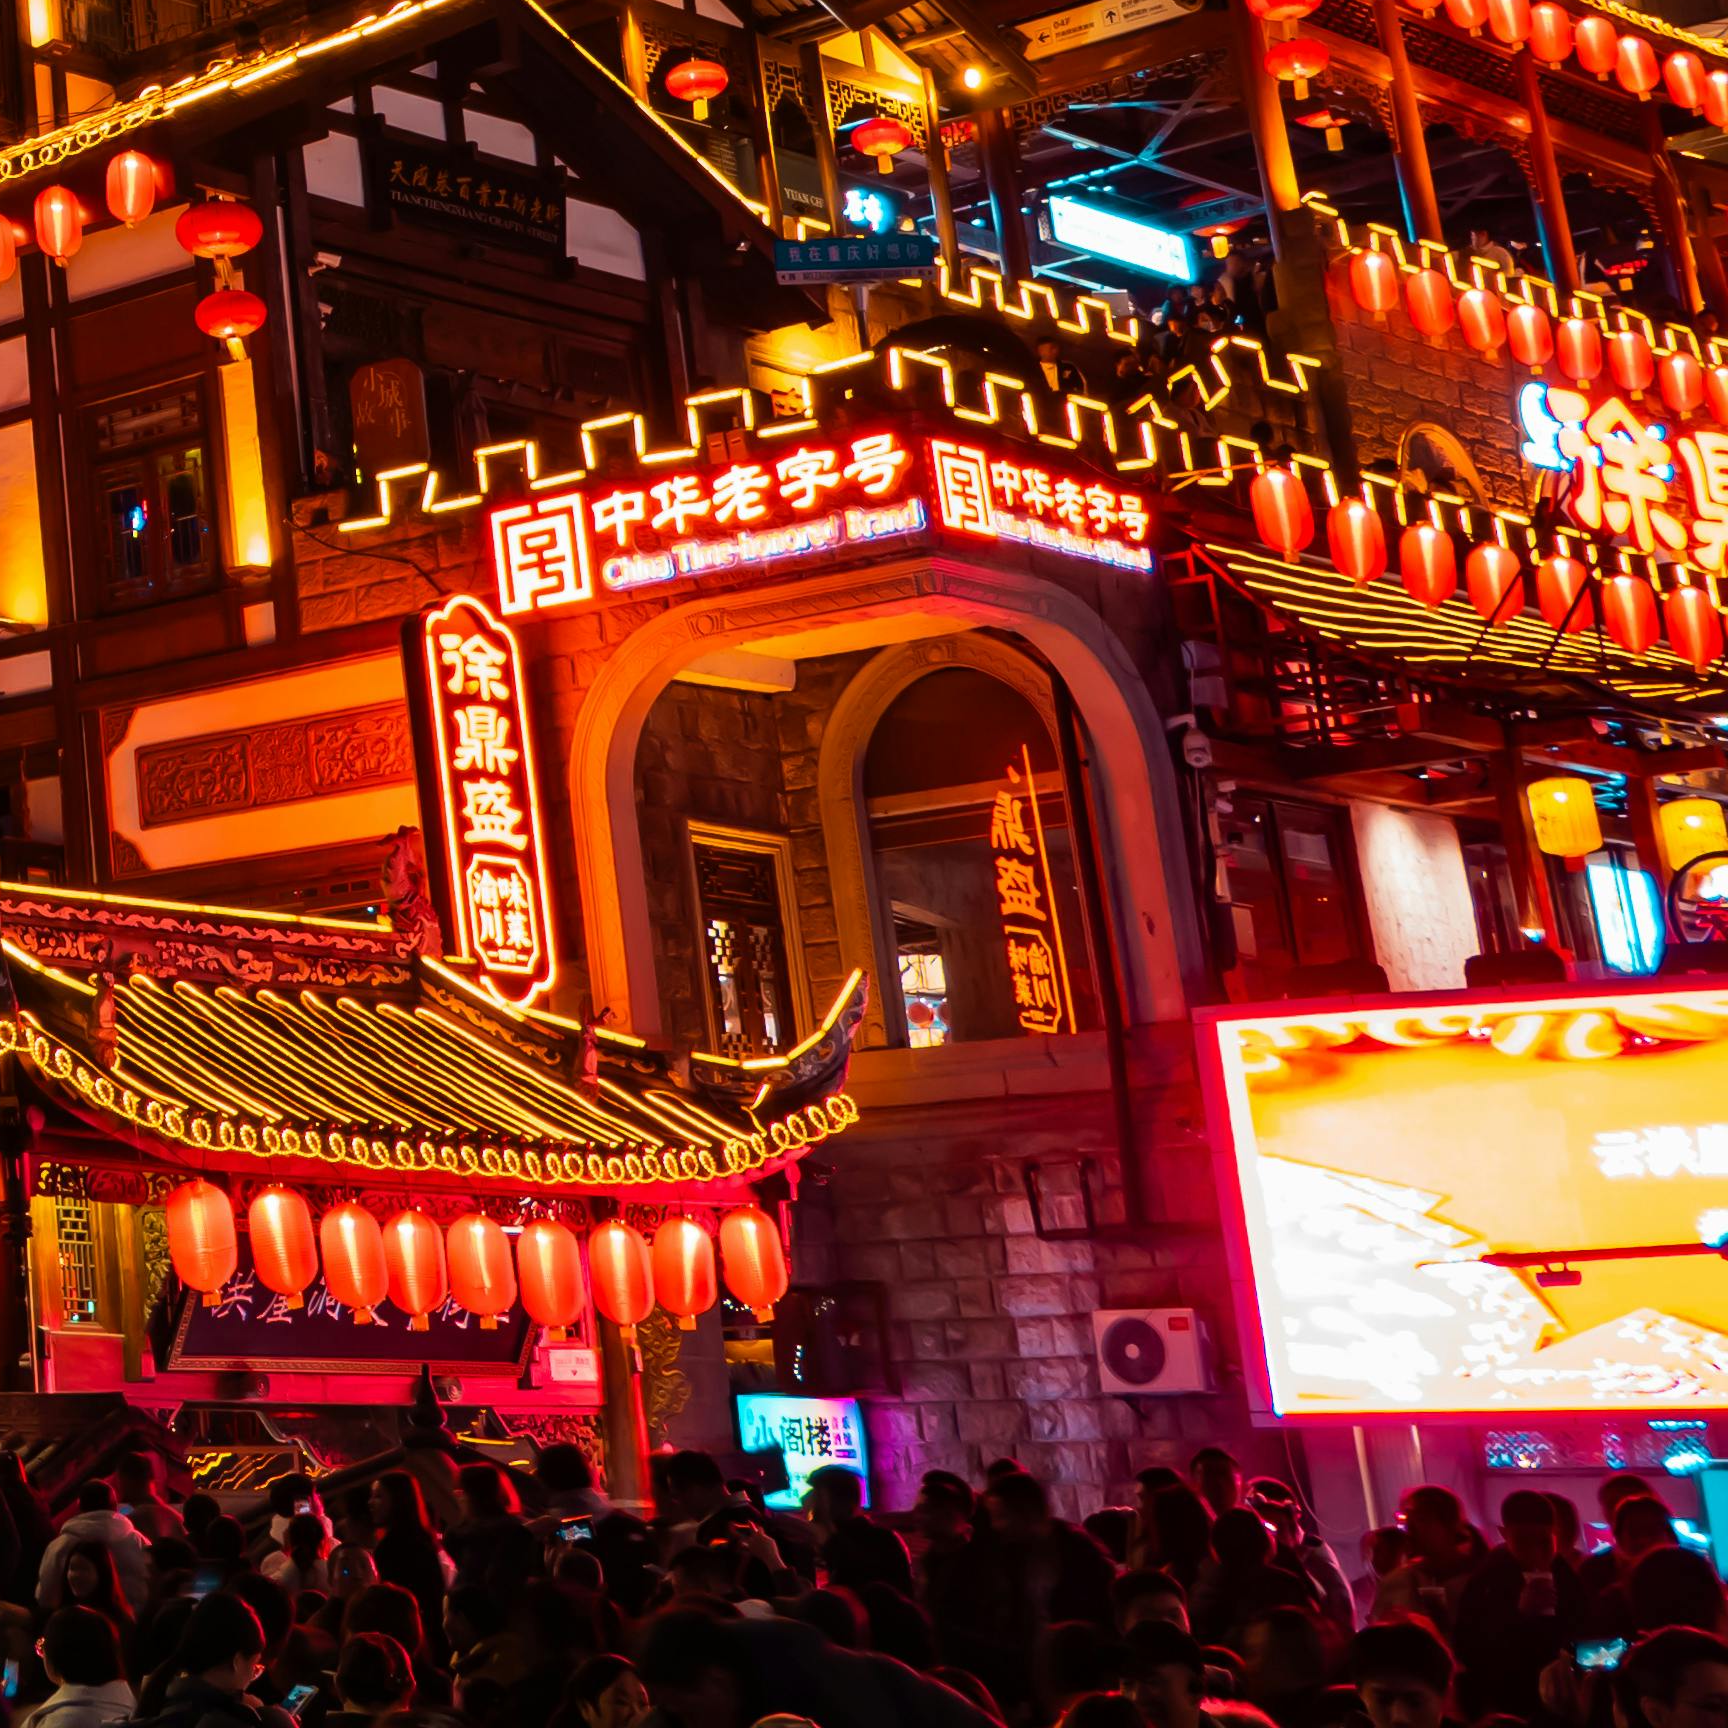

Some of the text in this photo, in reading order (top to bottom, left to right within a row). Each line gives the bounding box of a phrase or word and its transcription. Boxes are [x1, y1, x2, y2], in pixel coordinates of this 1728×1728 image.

[592, 434, 907, 547] 中华老字号
[990, 461, 1149, 541] 中华老字号
[604, 499, 926, 589] China Time-honored Brand
[439, 634, 528, 850] 徐鼎盛
